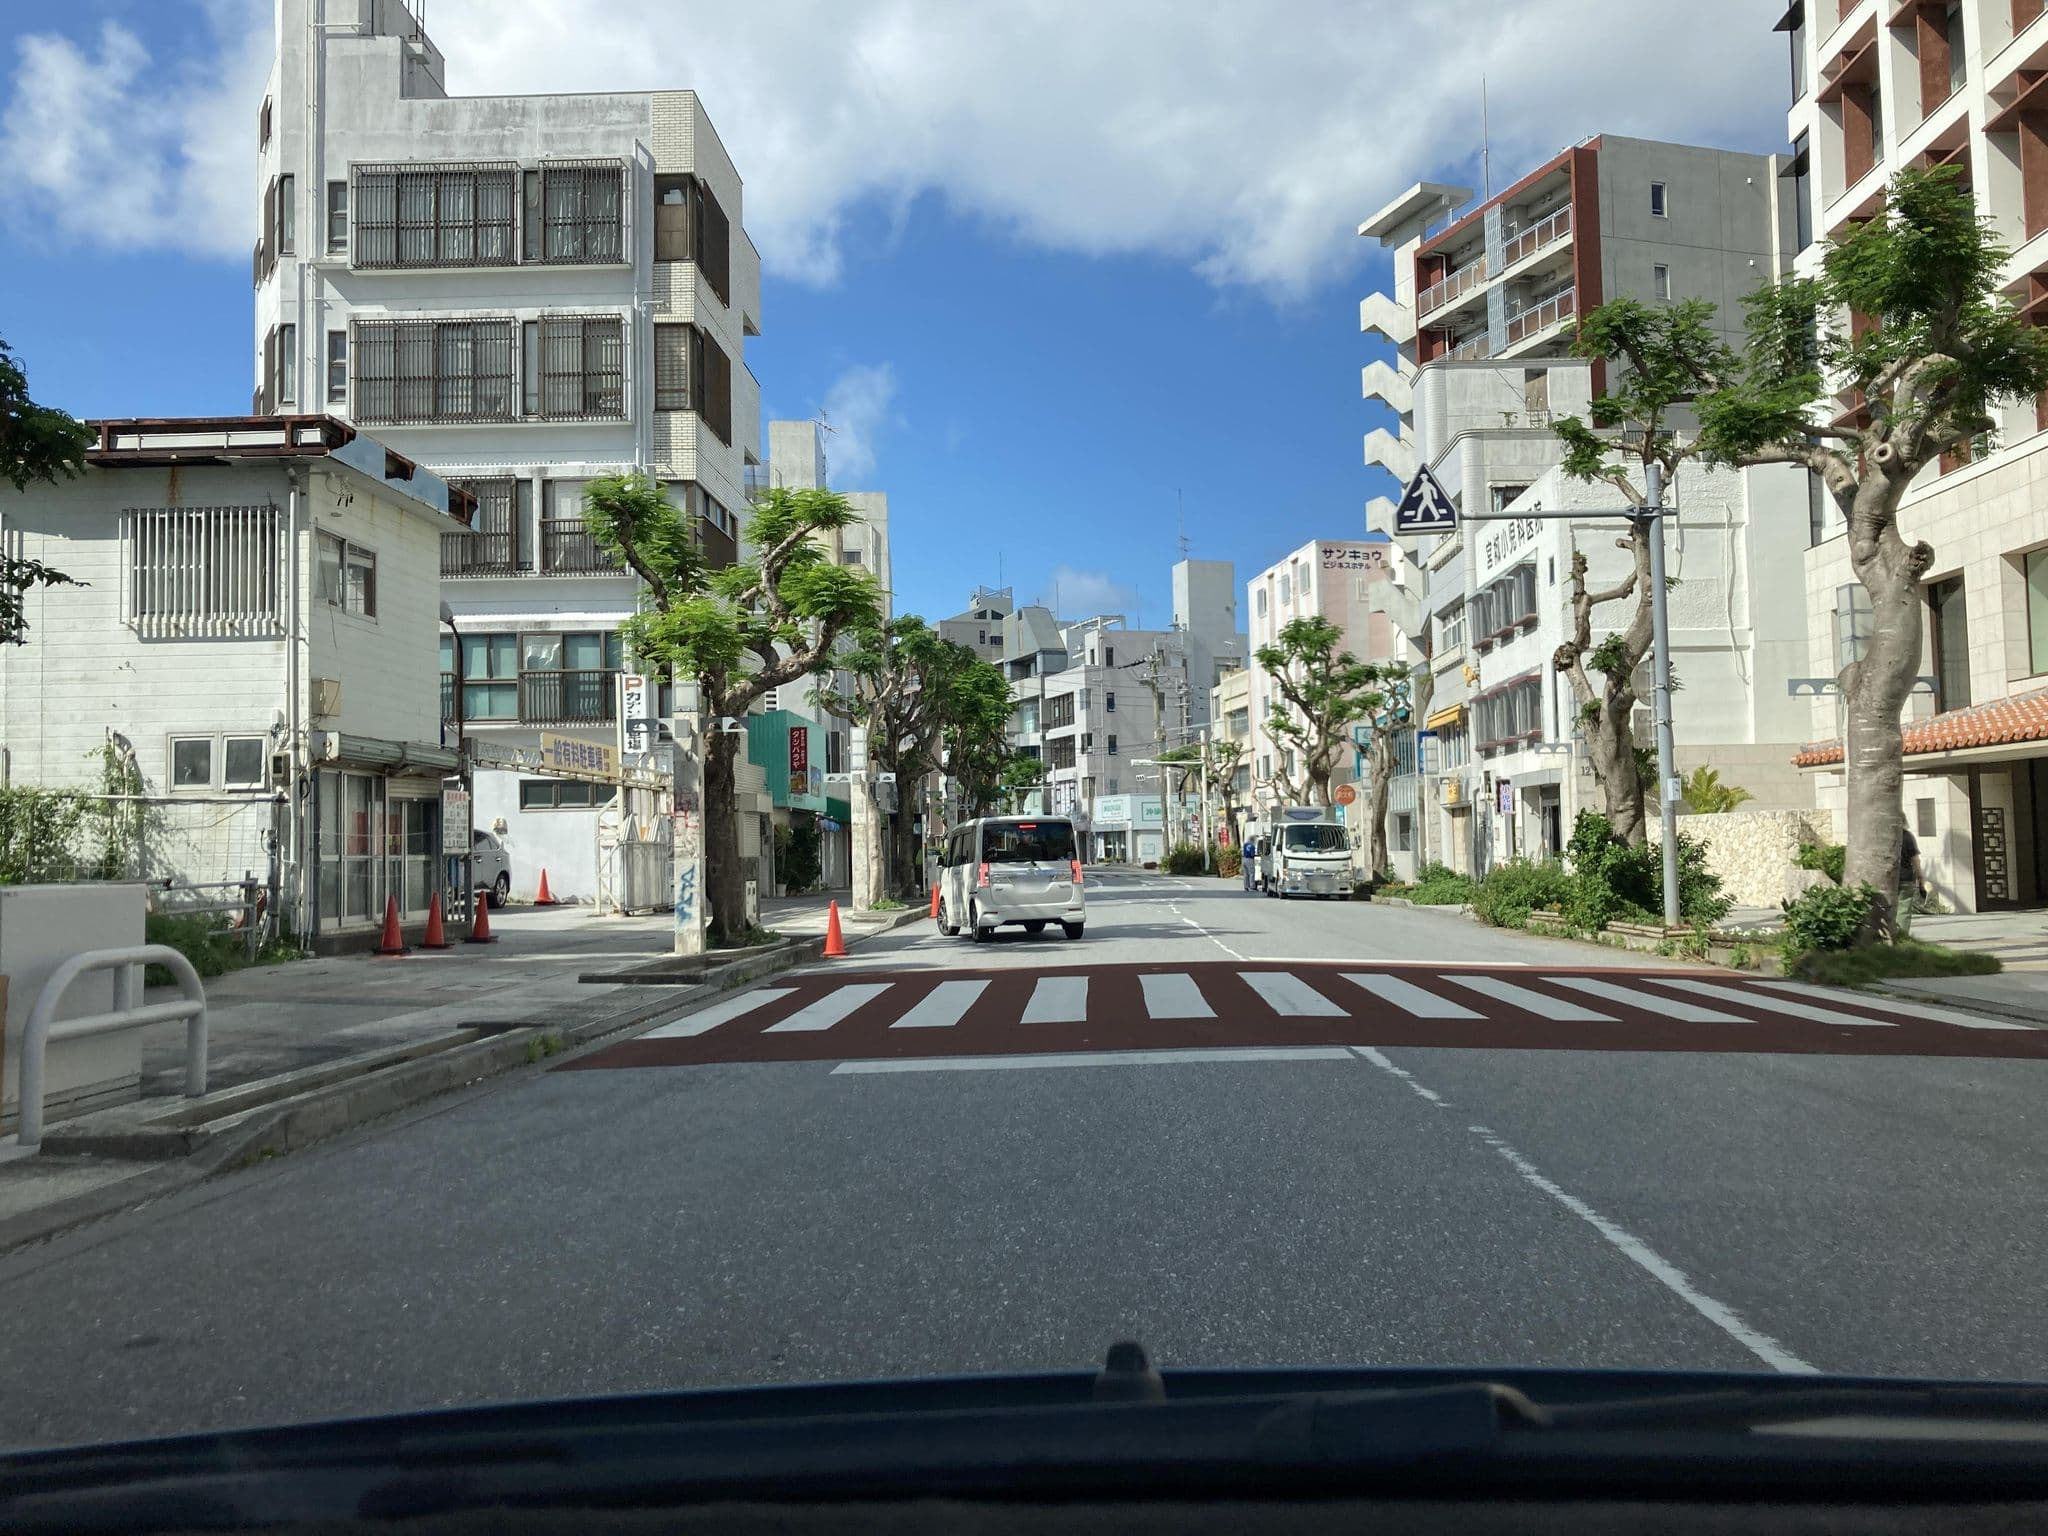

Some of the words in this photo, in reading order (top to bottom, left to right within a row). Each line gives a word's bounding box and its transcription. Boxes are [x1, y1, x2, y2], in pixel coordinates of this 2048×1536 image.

[1321, 547, 1382, 561] サンキョウ
[1323, 560, 1371, 570] ビジネスホテル
[625, 677, 643, 690] P
[1580, 766, 1592, 776] 12
